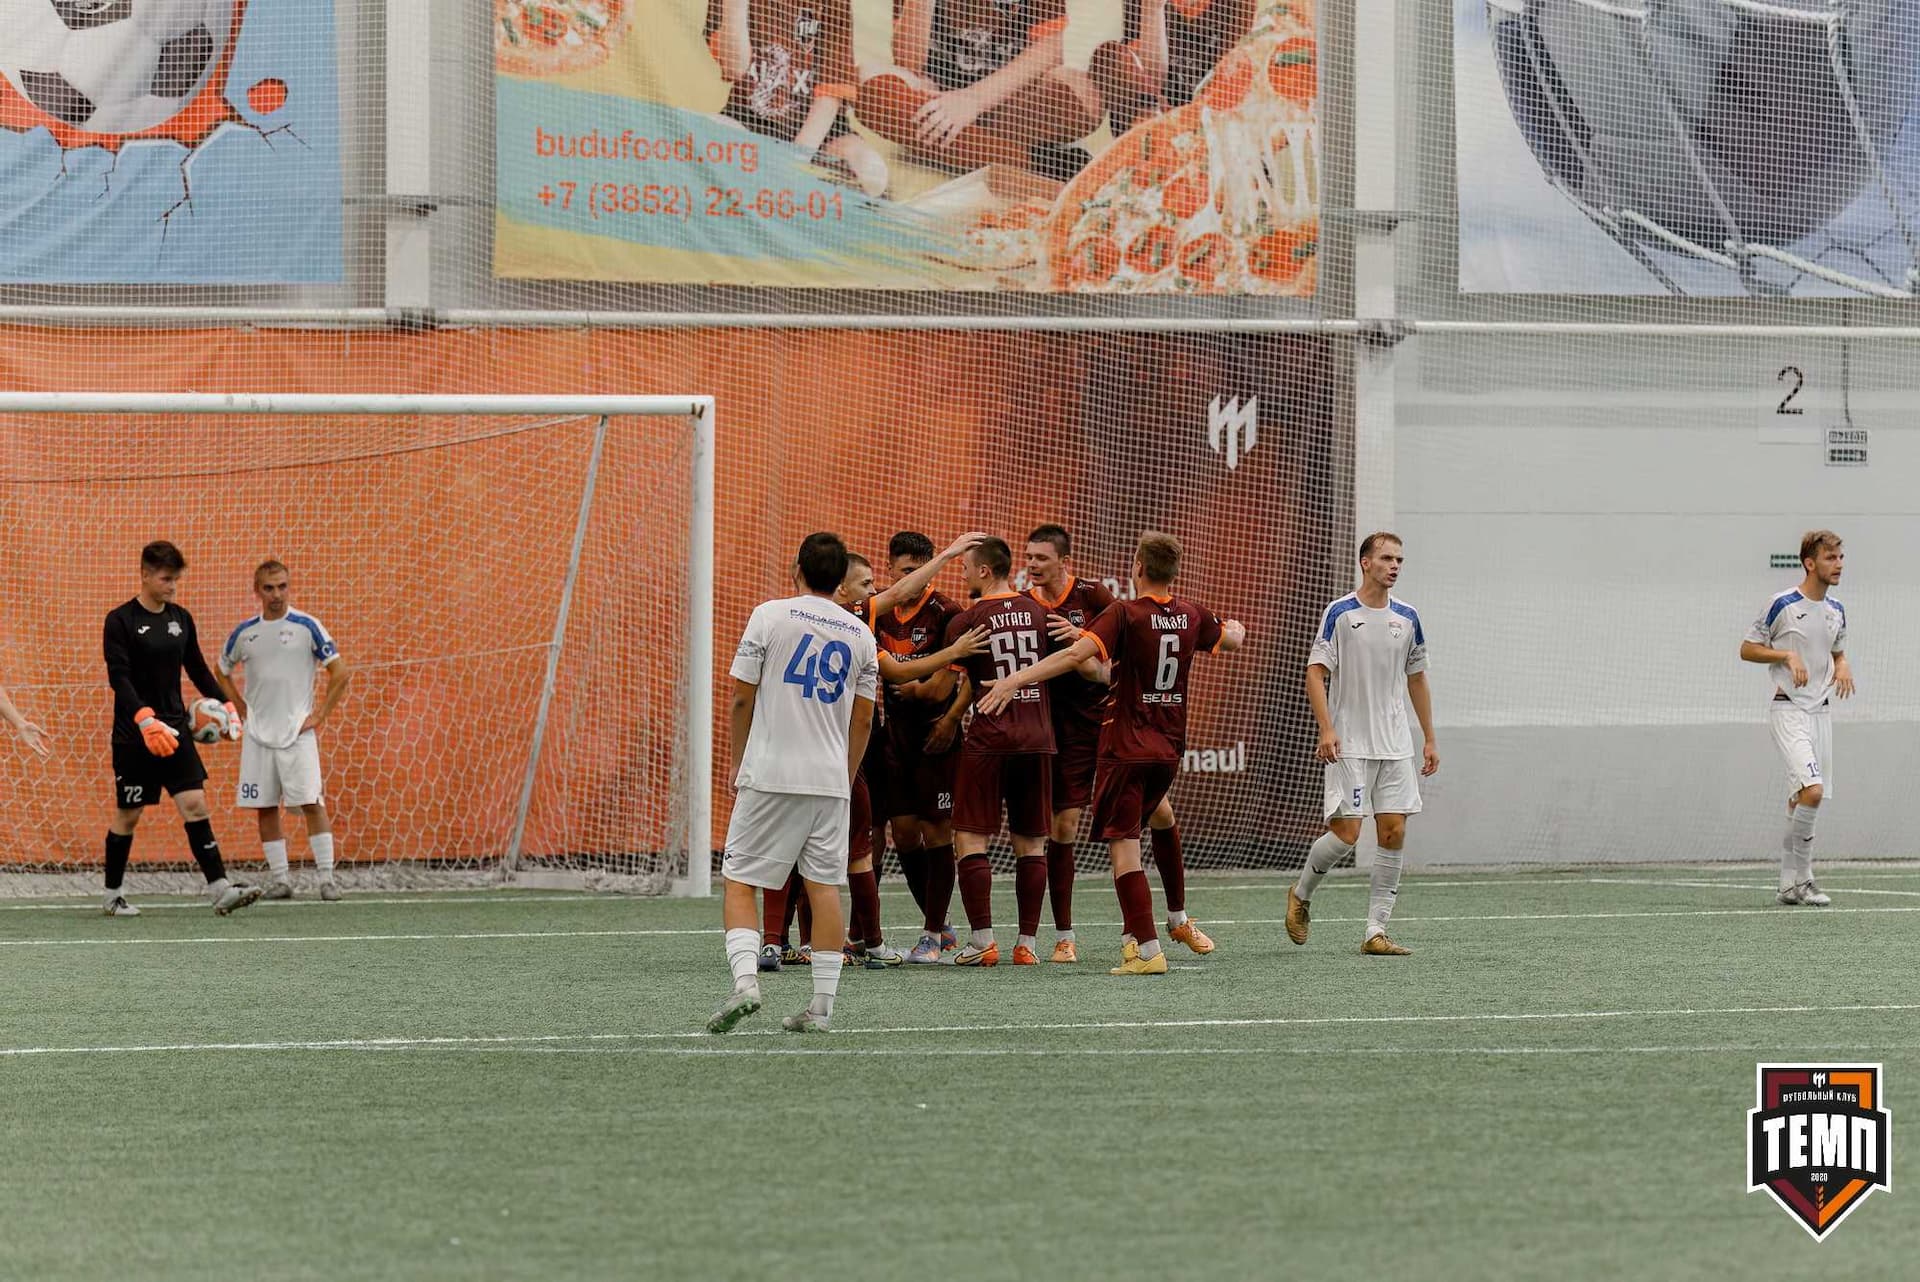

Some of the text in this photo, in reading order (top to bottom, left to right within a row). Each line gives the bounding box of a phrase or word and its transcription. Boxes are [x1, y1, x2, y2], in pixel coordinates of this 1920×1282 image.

[536, 126, 759, 173] budufood.org
[537, 181, 843, 223] +7 (3852) 22-66-01
[1777, 366, 1803, 415] 2
[783, 633, 852, 704] 49
[989, 630, 1039, 685] 55
[1155, 633, 1180, 690] 6
[124, 785, 143, 803] 72
[241, 783, 259, 799] 96
[937, 792, 951, 810] 22
[1353, 788, 1364, 808] 5
